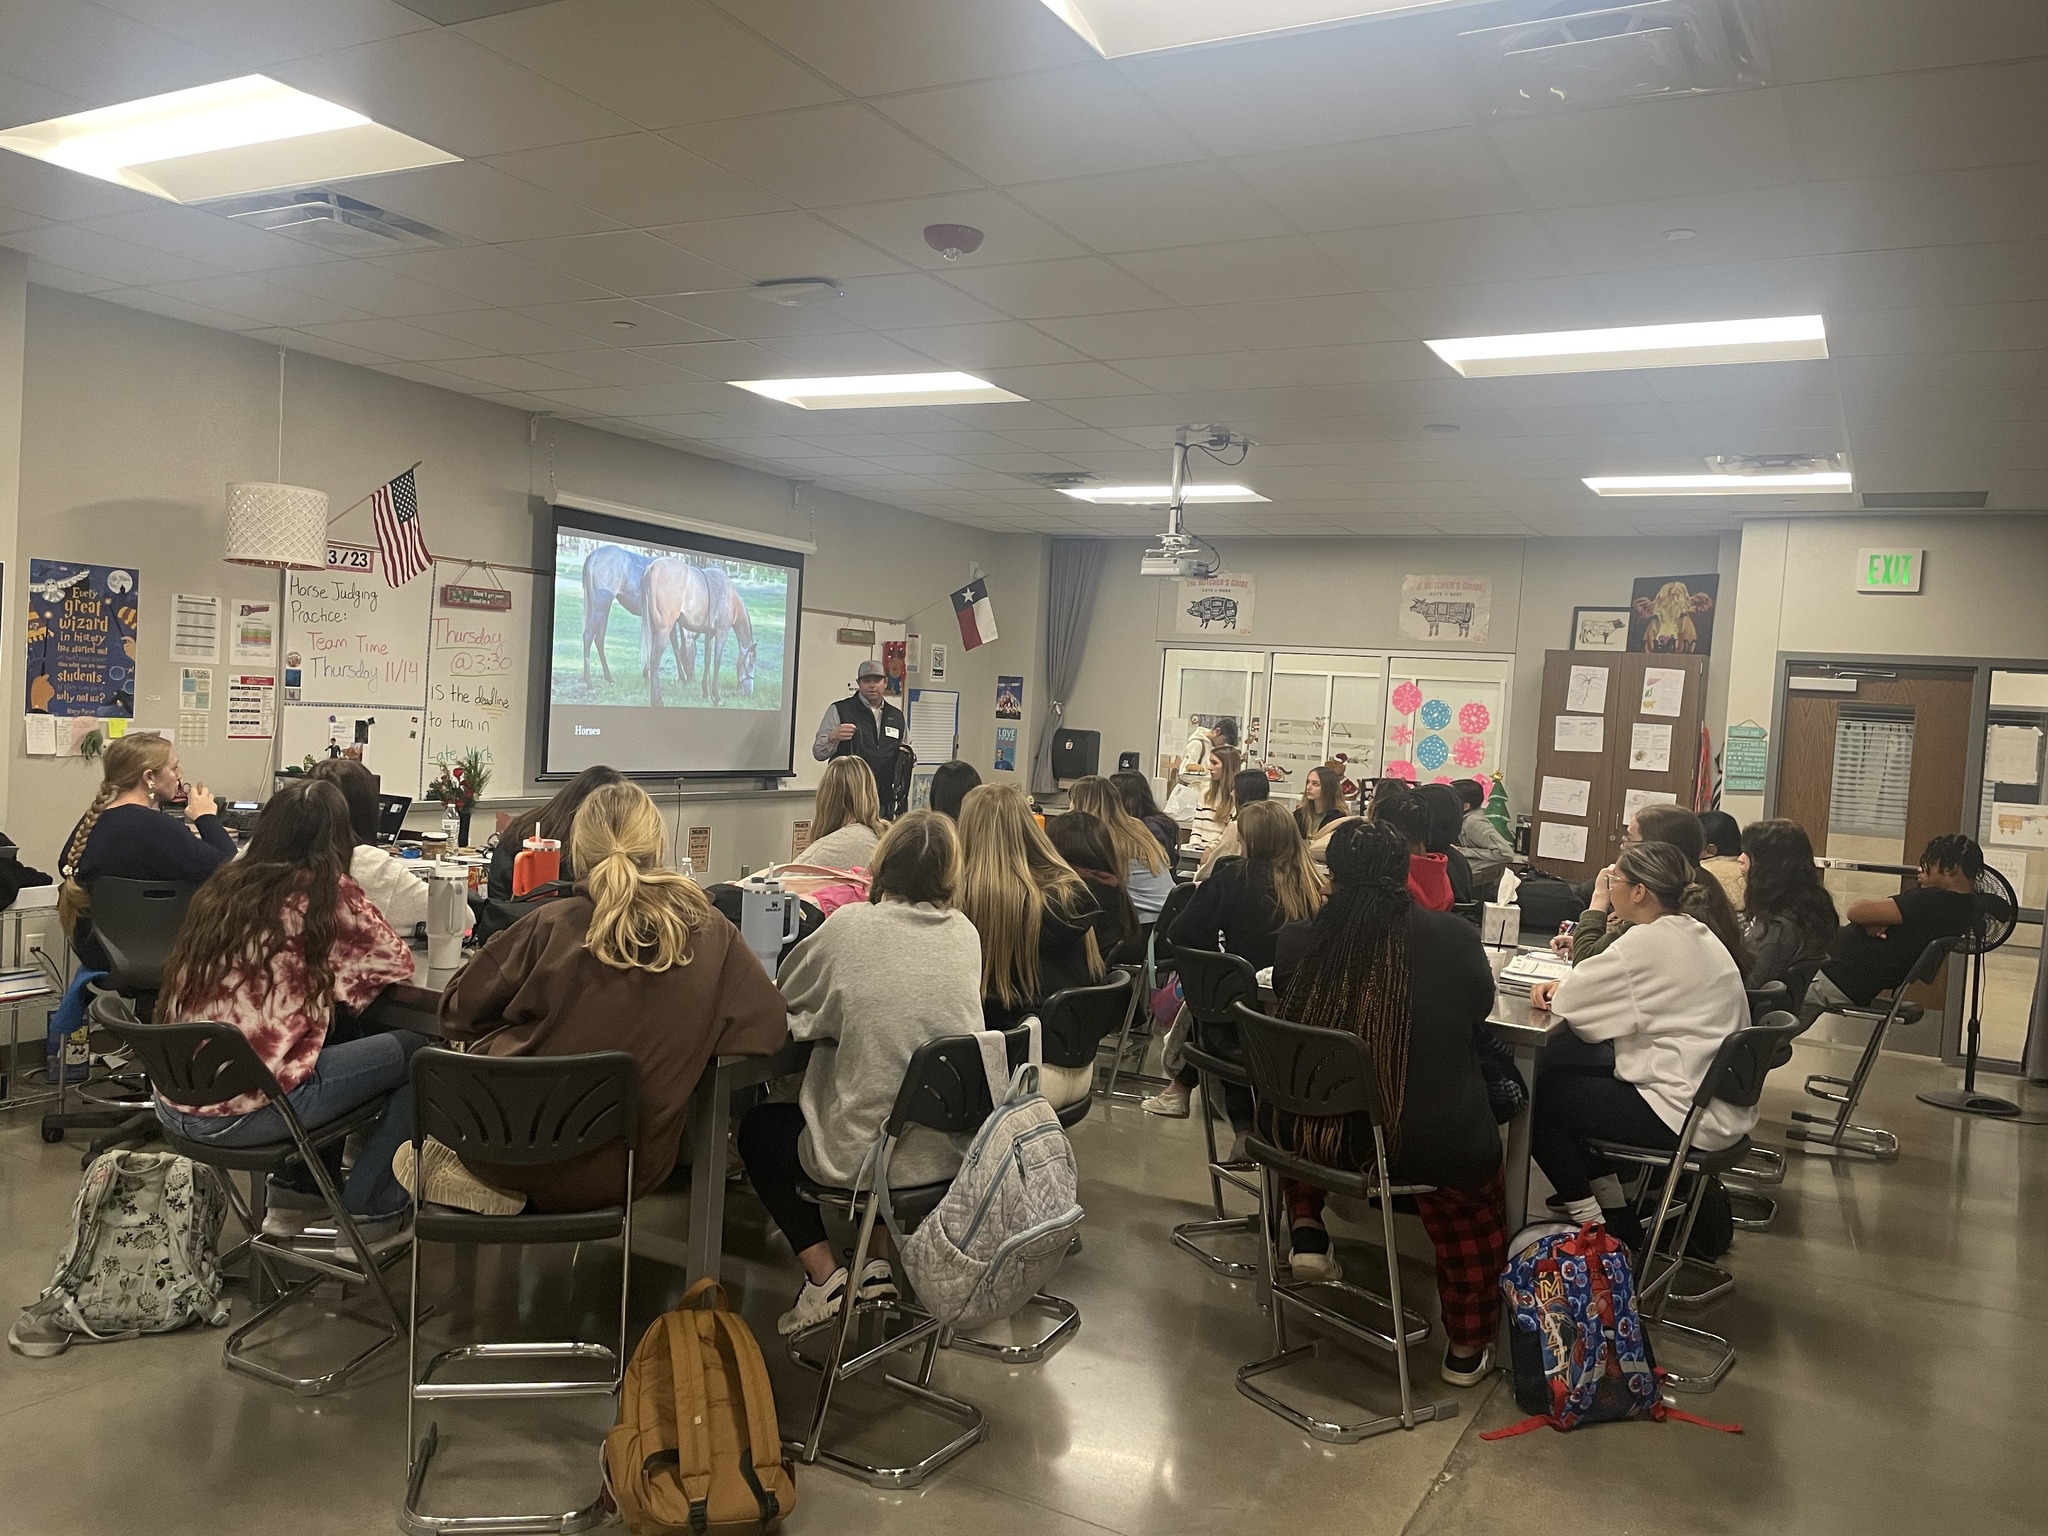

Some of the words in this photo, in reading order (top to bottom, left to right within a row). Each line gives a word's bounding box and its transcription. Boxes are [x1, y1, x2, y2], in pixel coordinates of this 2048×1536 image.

[1867, 554, 1913, 585] EXIT
[290, 575, 329, 600] Horse
[331, 581, 378, 612] Judging
[64, 600, 102, 618] great
[291, 600, 348, 624] Practice:
[58, 616, 109, 633] wizard
[57, 642, 70, 653] has
[71, 643, 96, 654] started
[60, 631, 71, 642] in
[74, 632, 106, 646] history
[307, 631, 348, 652] Team
[355, 634, 389, 656] Time
[432, 618, 505, 659] Thursday
[310, 656, 379, 694] Thursday
[385, 659, 419, 685] 11/14
[56, 690, 75, 704] why
[76, 693, 89, 703] not
[90, 692, 106, 704] us?
[450, 684, 470, 704] the
[474, 685, 509, 709] deadline
[429, 711, 443, 728] to
[450, 712, 474, 731] turn
[478, 720, 490, 733] in
[574, 725, 601, 736] Horses
[998, 728, 1015, 738] LOVE
[428, 737, 458, 762] Late
